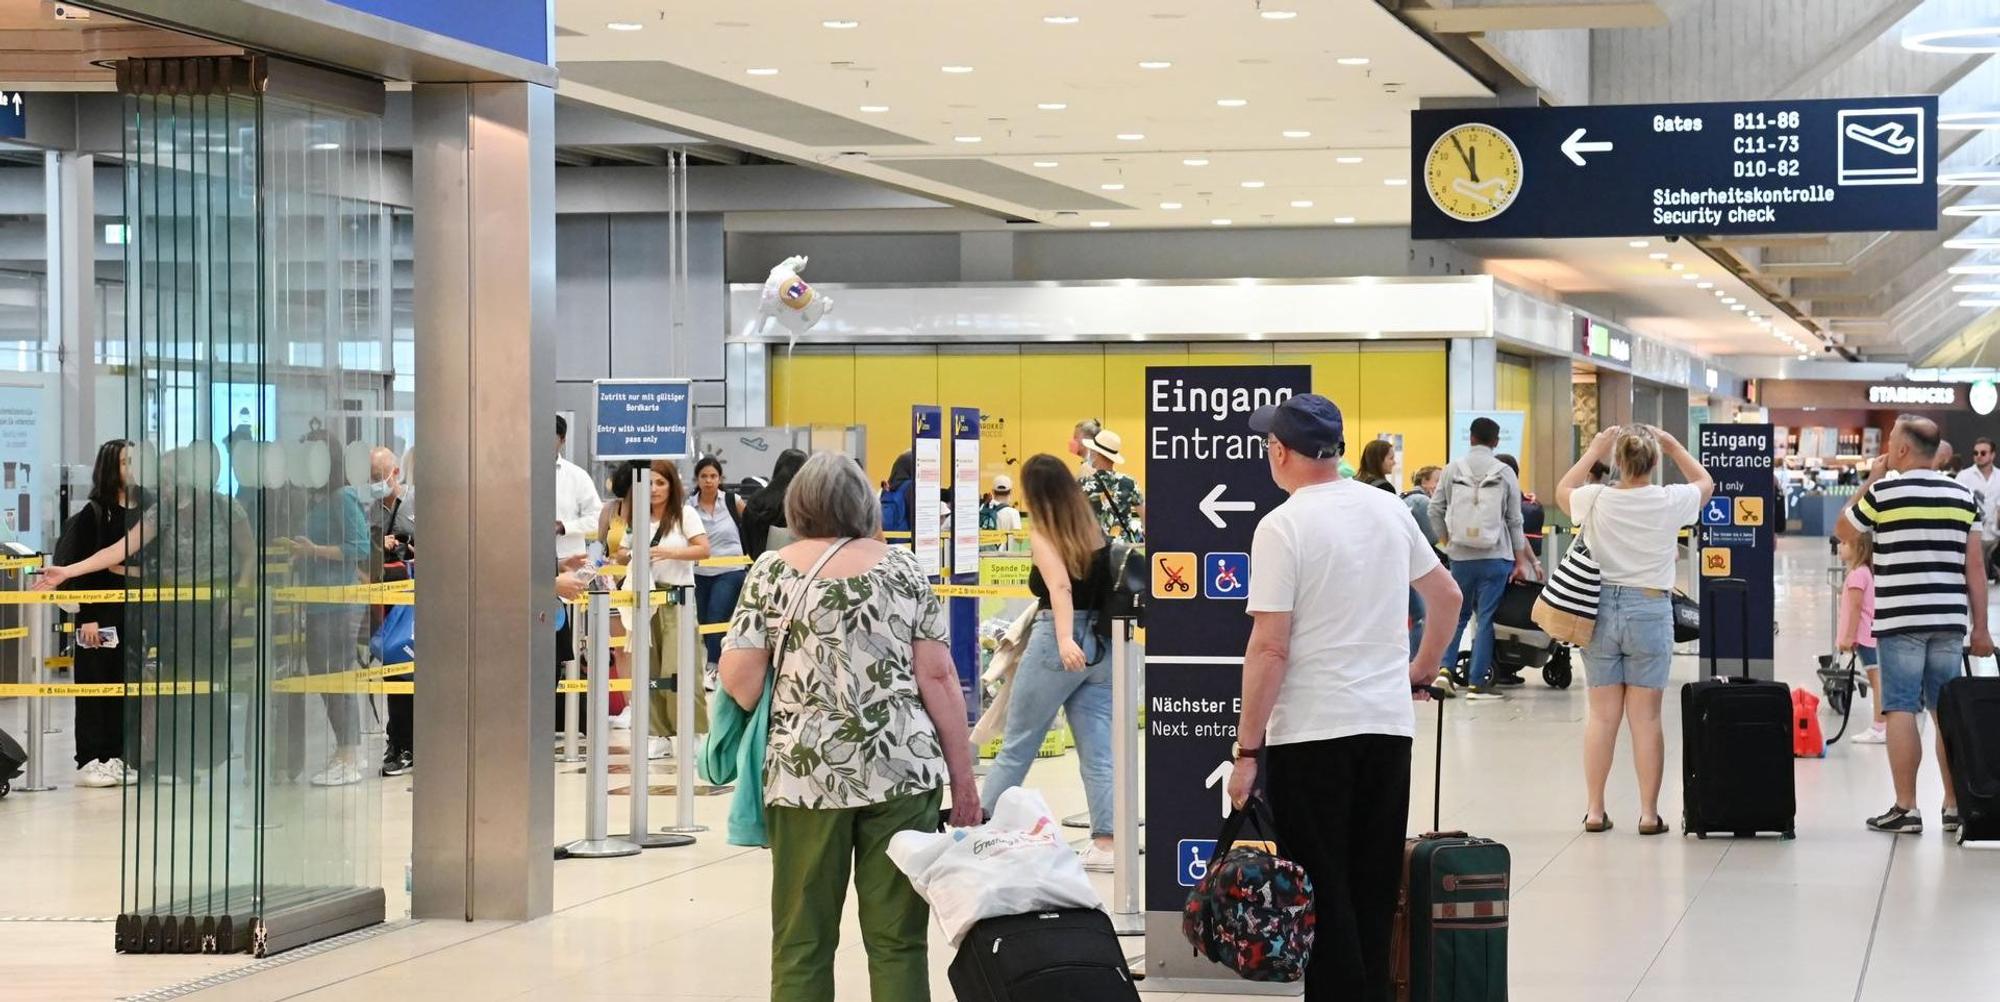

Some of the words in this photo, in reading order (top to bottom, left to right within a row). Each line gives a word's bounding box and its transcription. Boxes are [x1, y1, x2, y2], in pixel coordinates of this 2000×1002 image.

[1653, 115, 1703, 132] Gates
[1733, 111, 1800, 130] B11-86
[1469, 134, 1478, 142] 12
[1733, 135, 1800, 154] C11-73
[1733, 159, 1800, 177] D10-82
[1653, 185, 1835, 205] Sicherheitskontrolle
[1653, 207, 1722, 226] Security
[1728, 205, 1776, 223] check
[600, 393, 626, 401] Zutritt
[642, 393, 654, 401] mit
[656, 393, 685, 402] gültiger
[1869, 386, 1955, 404] STARBUCKS
[626, 403, 659, 412] Bordkarte
[597, 425, 616, 434] Entry
[618, 425, 635, 433] with
[637, 425, 655, 433] valid
[656, 425, 686, 434] boarding
[625, 436, 641, 444] pass
[643, 435, 658, 444] only
[1152, 426, 1266, 460] Entran
[1701, 431, 1767, 451] Eingang
[1701, 452, 1772, 468] Entrance
[1725, 481, 1744, 492] only
[991, 564, 1018, 573] Spende
[1152, 697, 1226, 713] Nächster
[1152, 720, 1188, 736] Next
[1194, 721, 1238, 737] entra
